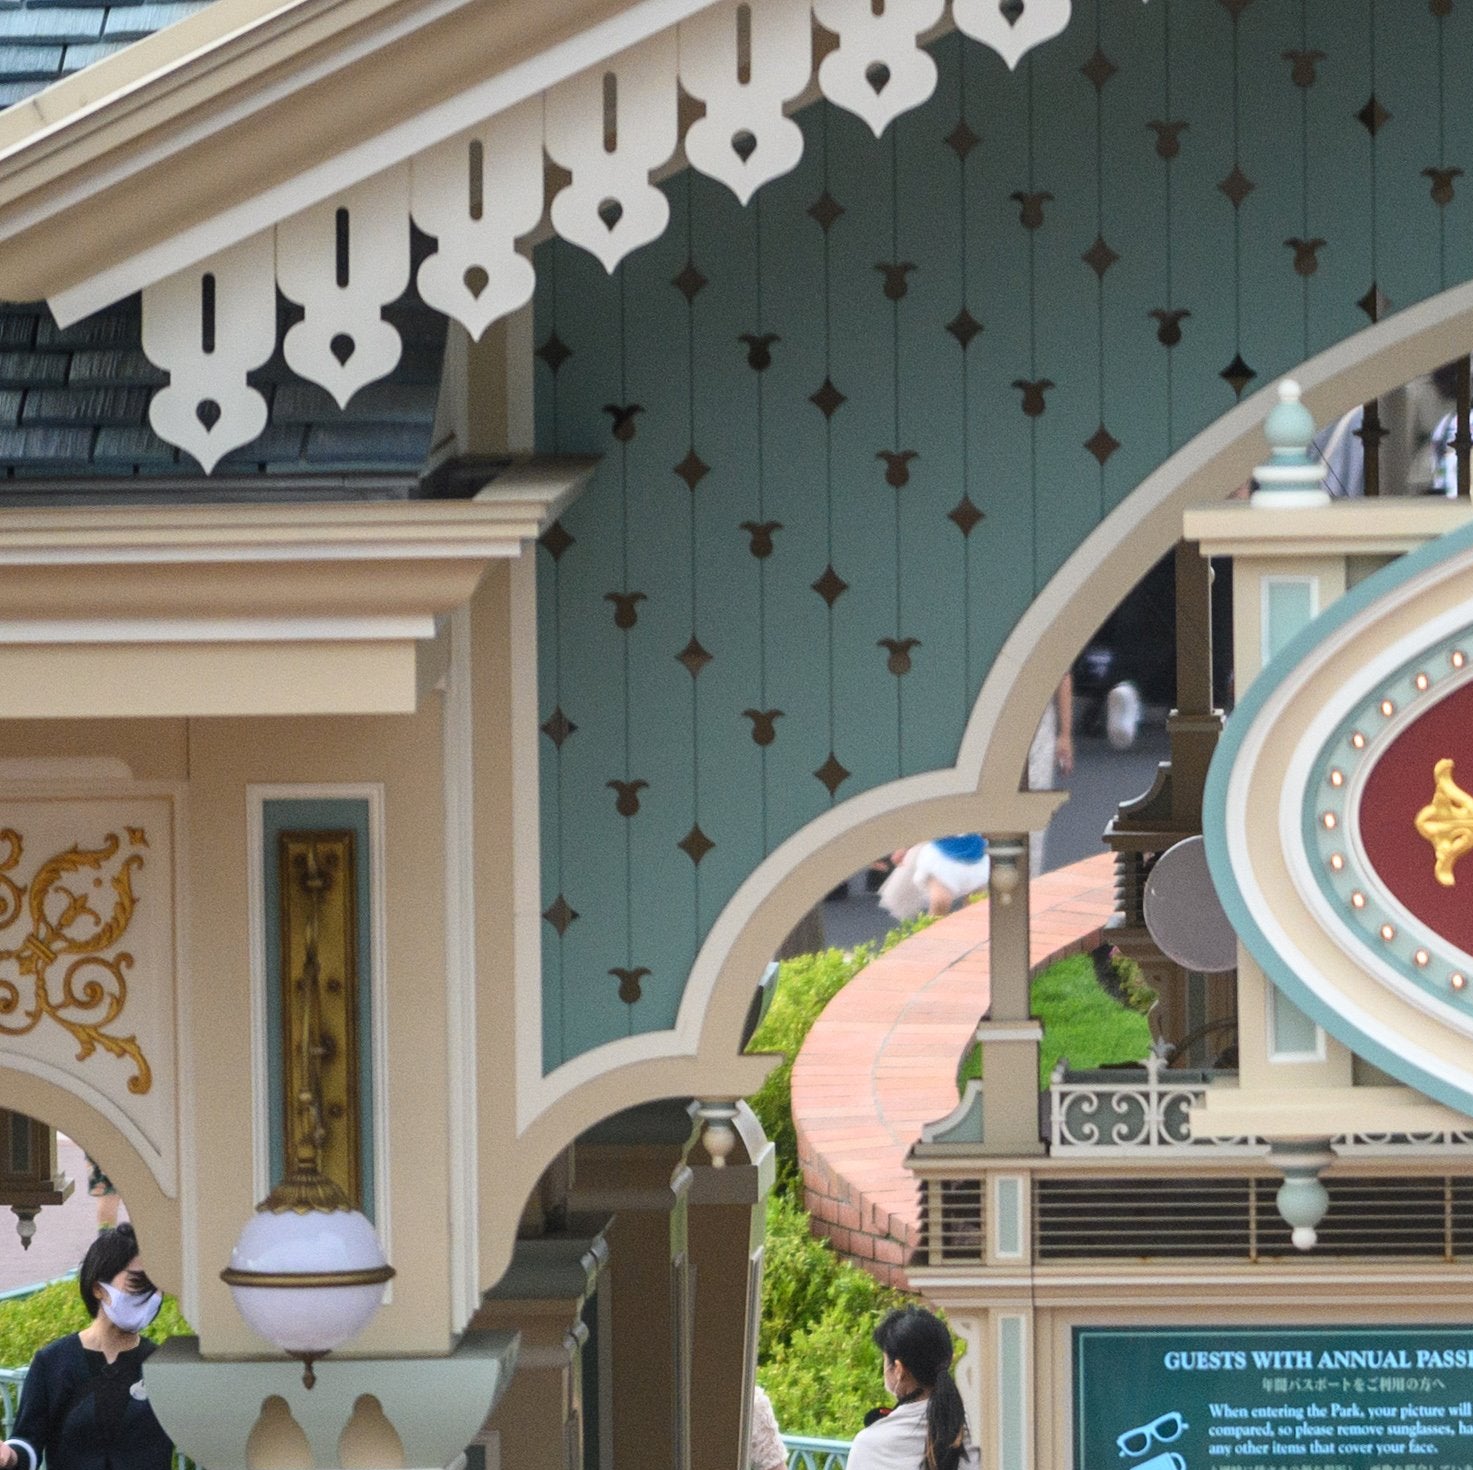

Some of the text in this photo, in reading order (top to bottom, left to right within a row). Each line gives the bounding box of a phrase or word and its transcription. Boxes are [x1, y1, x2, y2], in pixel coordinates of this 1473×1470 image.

[1164, 1351, 1247, 1370] GUESTS
[1250, 1351, 1313, 1369] WITH
[1317, 1350, 1412, 1369] ANNUAL
[1208, 1403, 1249, 1418] When
[1250, 1404, 1304, 1421] entering
[1306, 1402, 1328, 1418] the
[1367, 1406, 1397, 1420] your
[1400, 1402, 1445, 1420] picture
[1448, 1402, 1471, 1417] will
[1277, 1426, 1292, 1437] so
[1295, 1421, 1334, 1440] please
[1337, 1425, 1385, 1437] remove
[1387, 1420, 1455, 1438] sunglasses,
[1209, 1438, 1438, 1457] any other items that cover your face.
